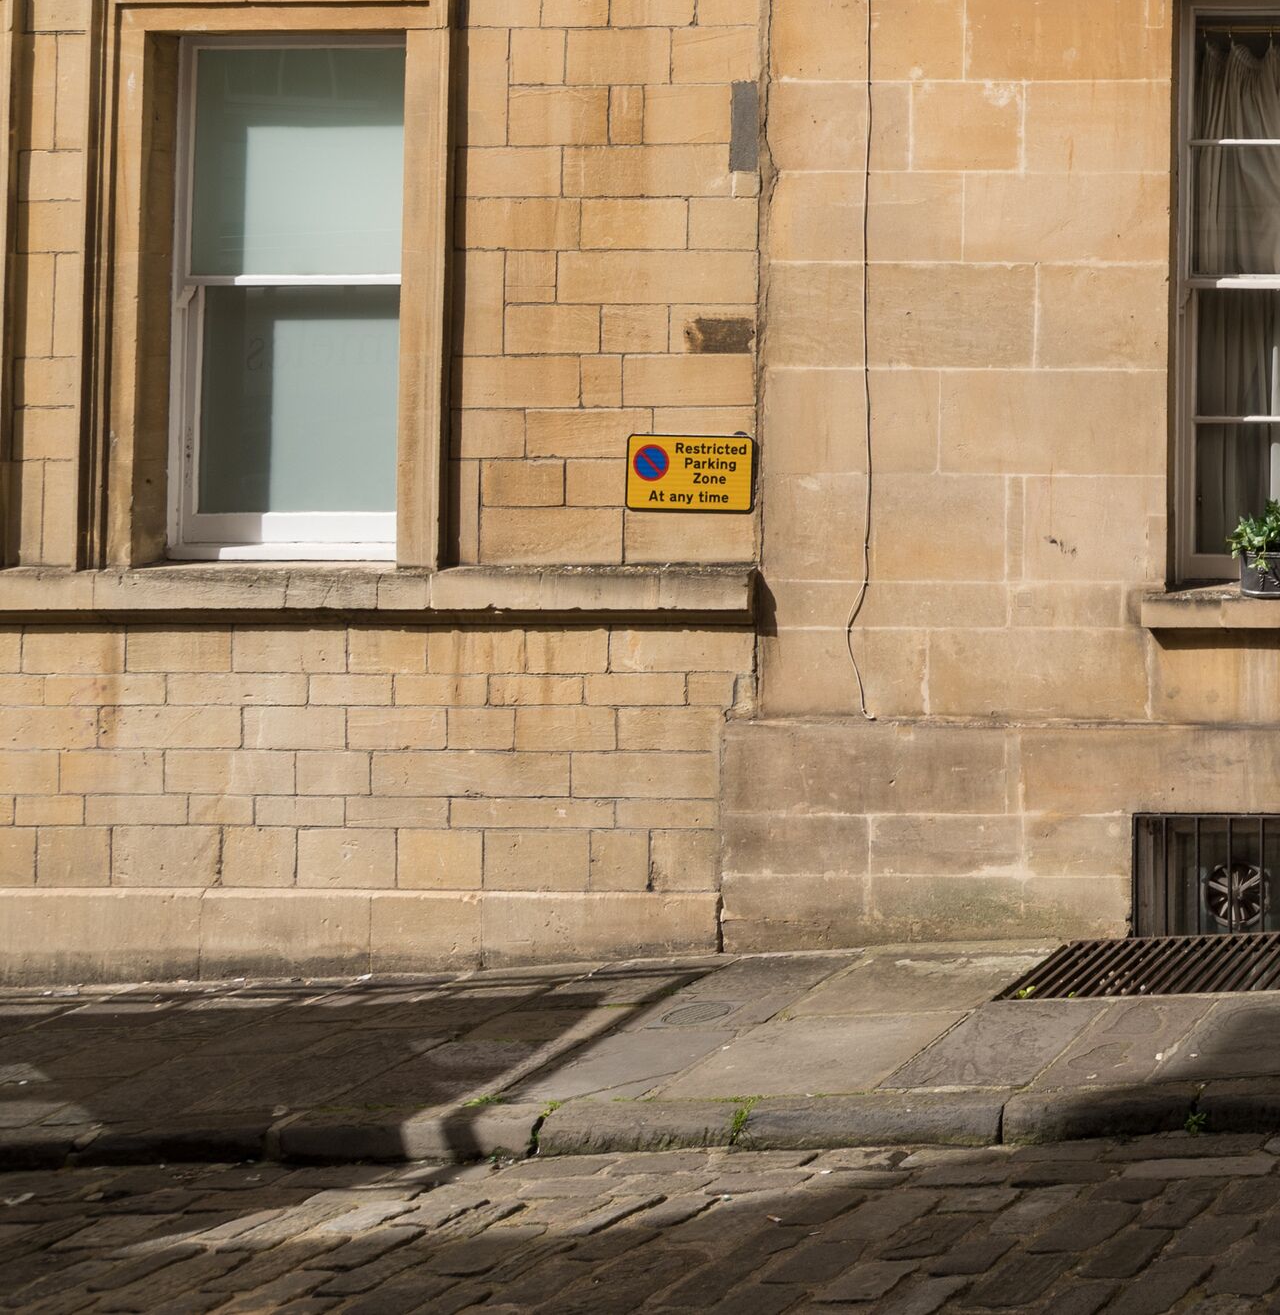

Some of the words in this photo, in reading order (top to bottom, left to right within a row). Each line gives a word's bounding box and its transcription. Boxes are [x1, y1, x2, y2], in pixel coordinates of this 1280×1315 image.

[675, 442, 747, 455] Restricted
[684, 458, 737, 472] Parking
[693, 472, 727, 485] Zone
[648, 490, 665, 502] At
[669, 492, 694, 505] any
[699, 491, 729, 503] time
